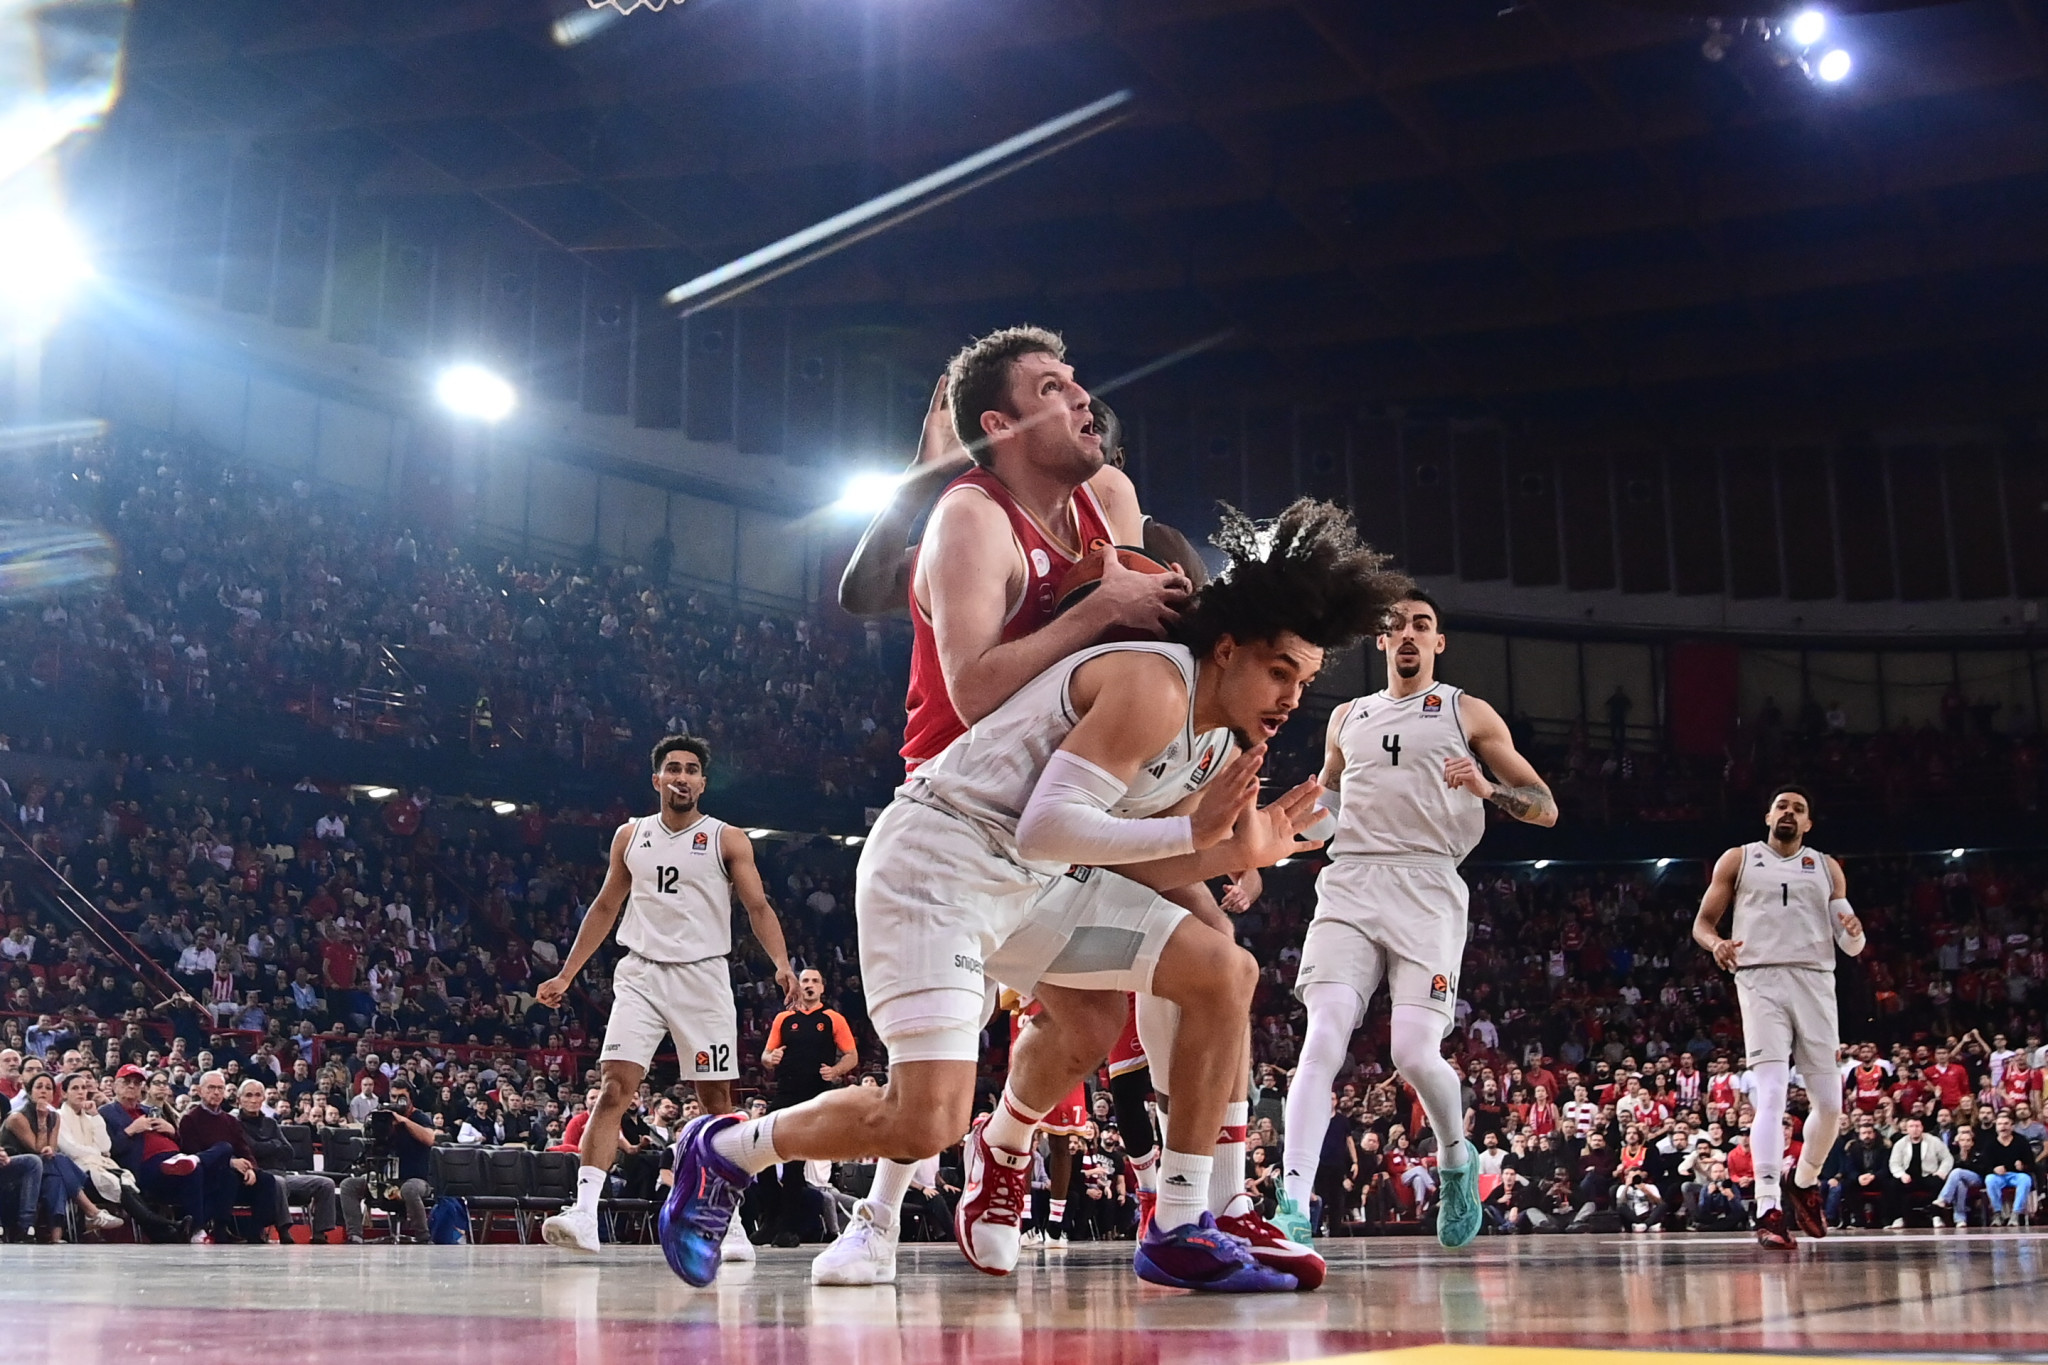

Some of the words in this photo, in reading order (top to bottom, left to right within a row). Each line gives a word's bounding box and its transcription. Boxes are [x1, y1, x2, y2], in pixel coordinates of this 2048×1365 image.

[1382, 734, 1401, 766] 4
[656, 866, 679, 894] 12
[1781, 883, 1788, 907] 1
[709, 1043, 730, 1072] 12
